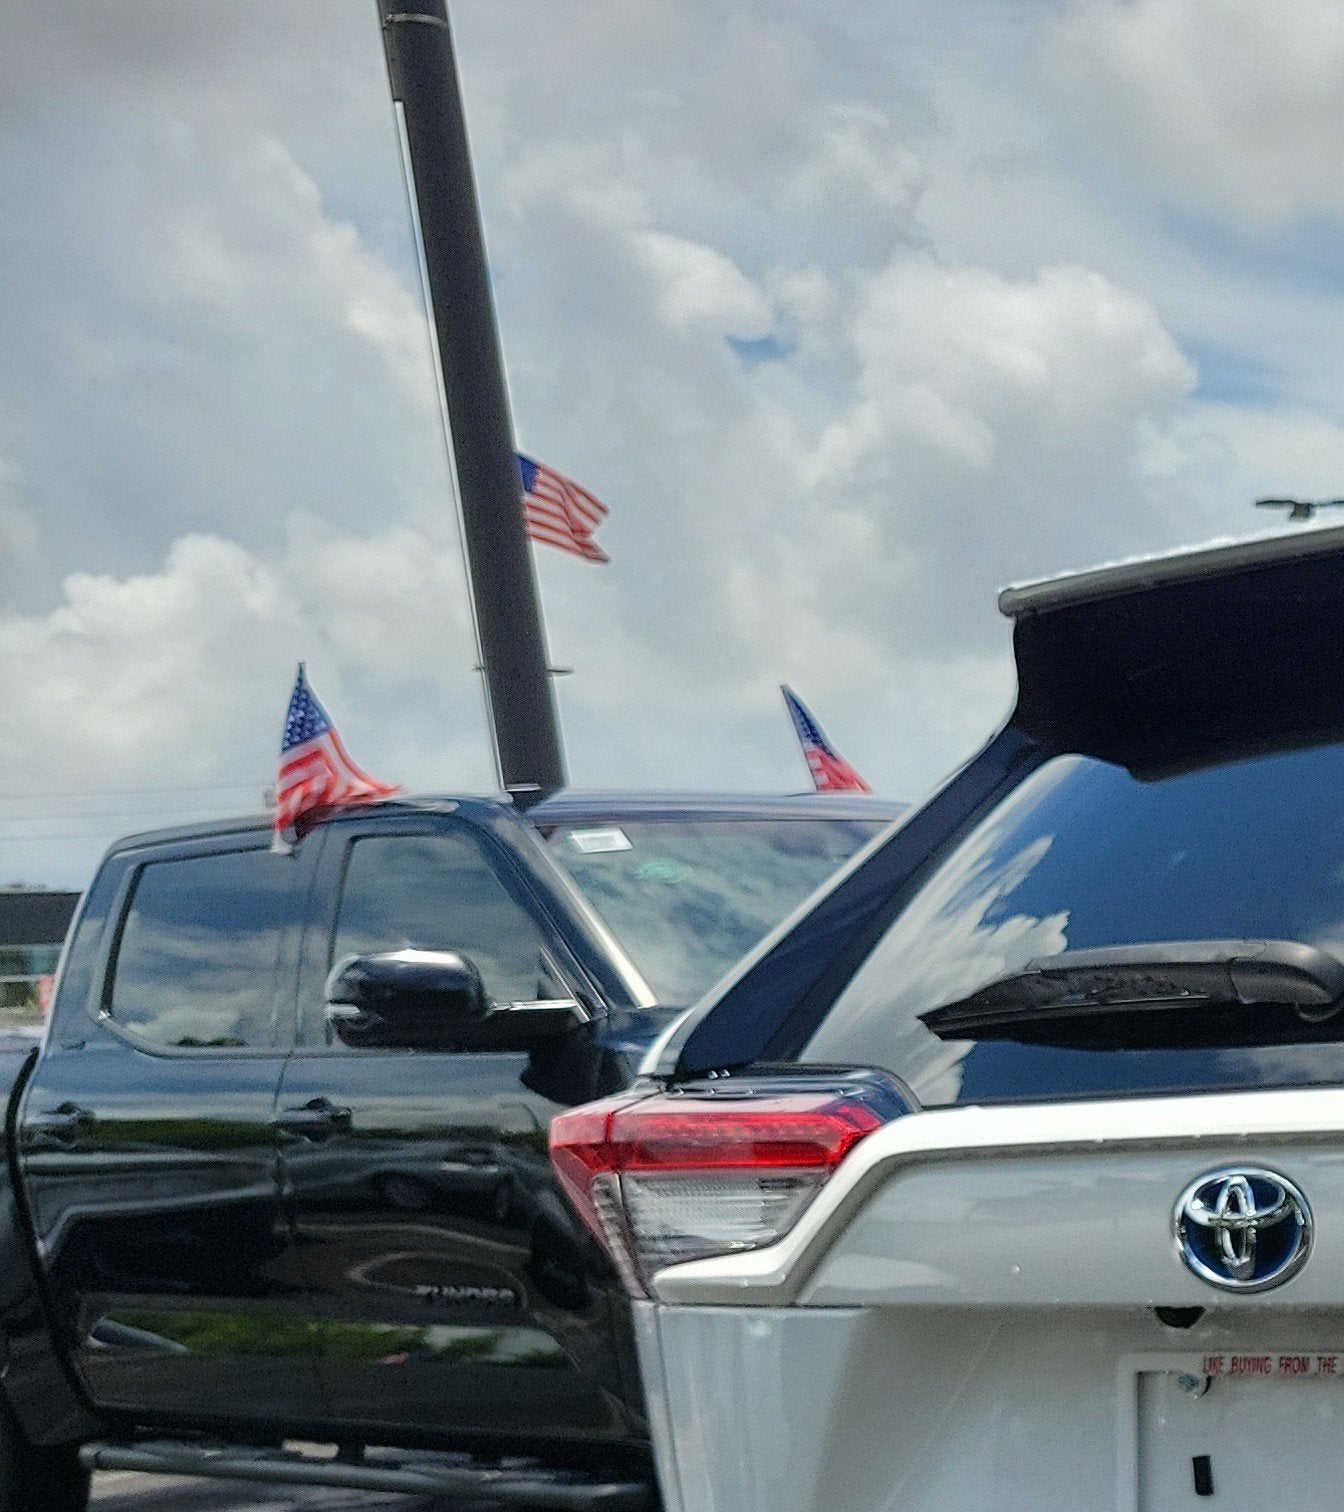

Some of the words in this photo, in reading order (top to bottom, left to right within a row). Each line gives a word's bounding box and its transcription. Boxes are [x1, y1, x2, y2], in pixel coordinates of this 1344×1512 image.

[1231, 1356, 1272, 1375] BUYING
[1279, 1356, 1310, 1375] FROM
[1317, 1356, 1338, 1375] THE
